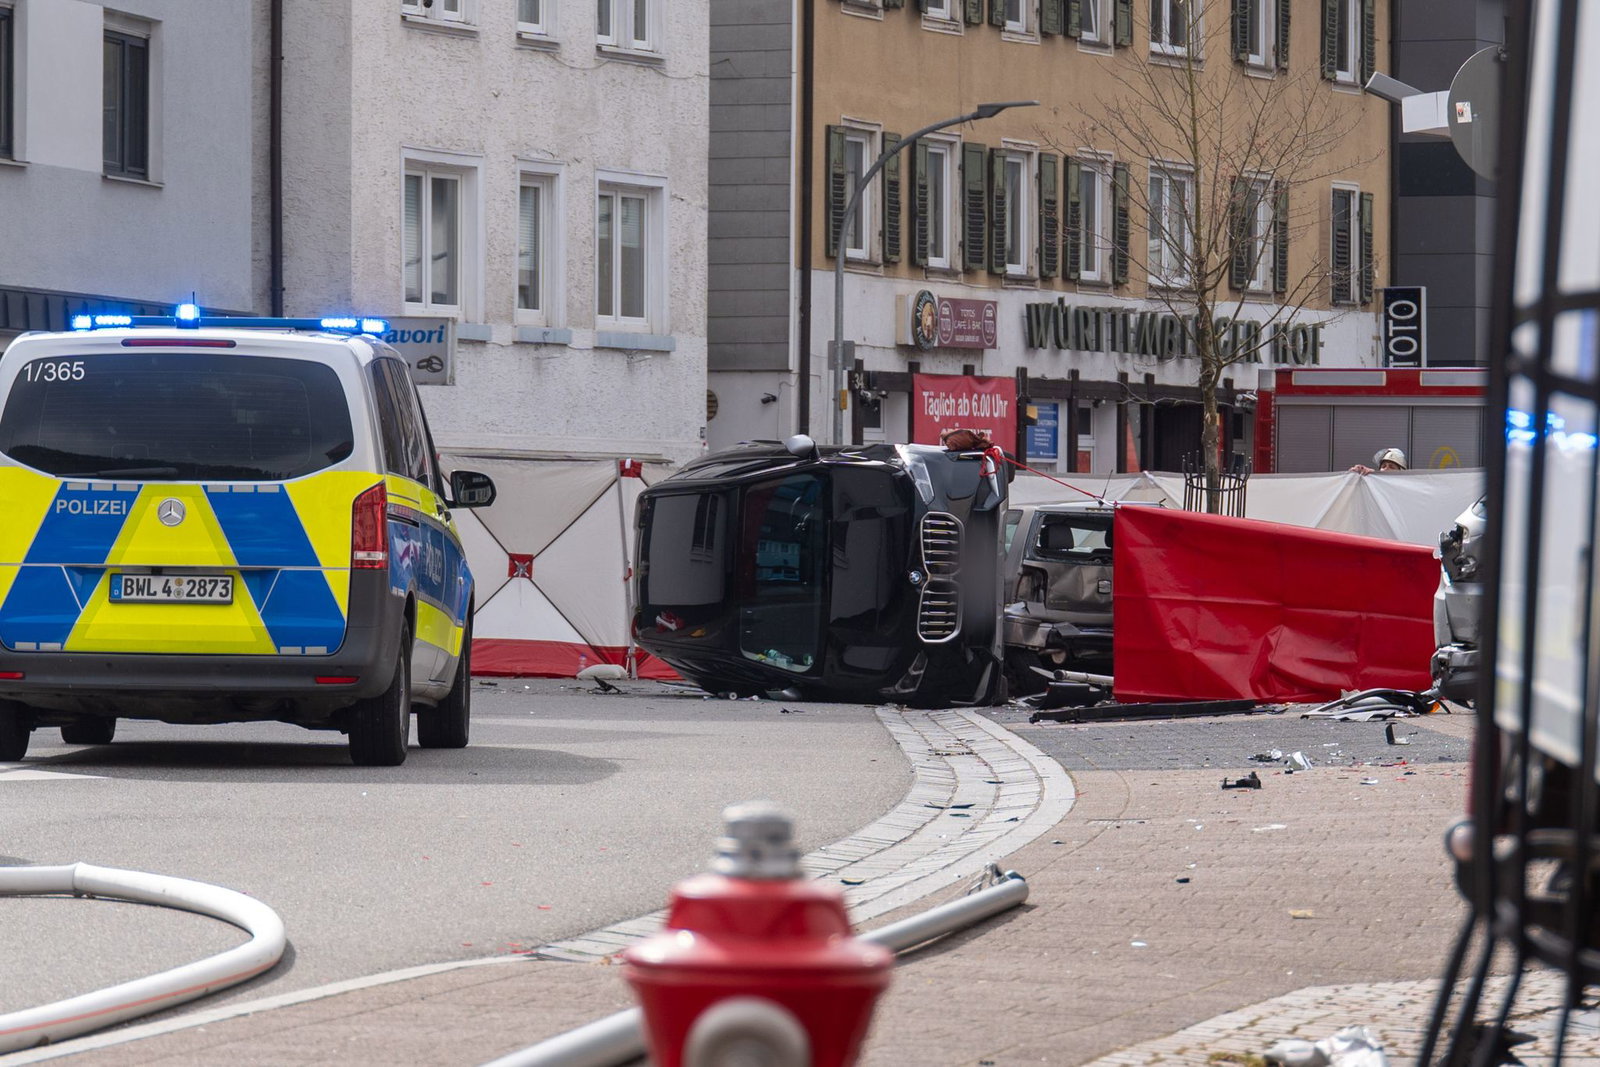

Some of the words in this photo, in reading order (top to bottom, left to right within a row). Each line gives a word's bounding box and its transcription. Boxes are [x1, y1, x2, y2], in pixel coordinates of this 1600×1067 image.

[383, 324, 445, 344] avori
[1272, 321, 1325, 365] HOF
[24, 361, 85, 382] 1/365
[922, 391, 956, 422] Täglich
[957, 392, 970, 416] ab
[971, 393, 991, 417] 6.00
[992, 393, 1008, 418] Uhr
[56, 499, 127, 515] POLIZEI
[123, 578, 157, 597] BWL
[162, 579, 172, 597] 4
[186, 579, 230, 598] 2873
